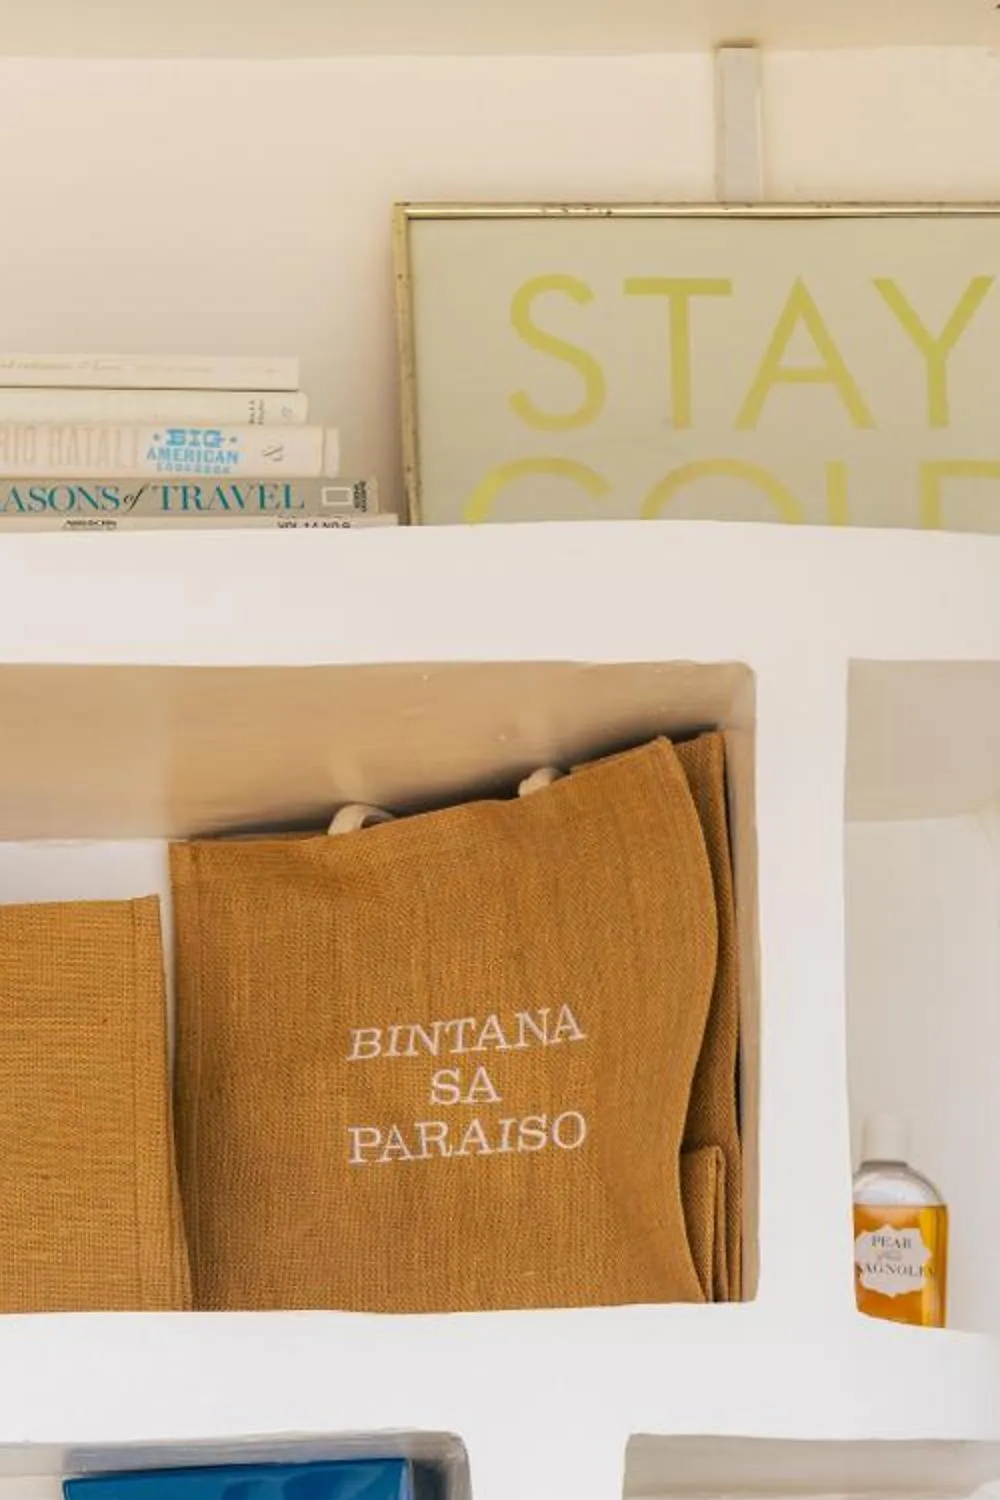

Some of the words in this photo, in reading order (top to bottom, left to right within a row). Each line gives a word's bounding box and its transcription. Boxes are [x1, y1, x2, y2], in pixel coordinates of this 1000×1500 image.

[508, 273, 996, 431] STAY
[146, 447, 239, 465] AMERICAN
[165, 428, 223, 449] BIG
[122, 480, 152, 514] of
[151, 482, 305, 512] TRAVEL
[346, 1002, 588, 1061] BINTANA
[430, 1065, 502, 1104] SA
[348, 1110, 587, 1164] PARAISO
[871, 1234, 913, 1249] PEAR
